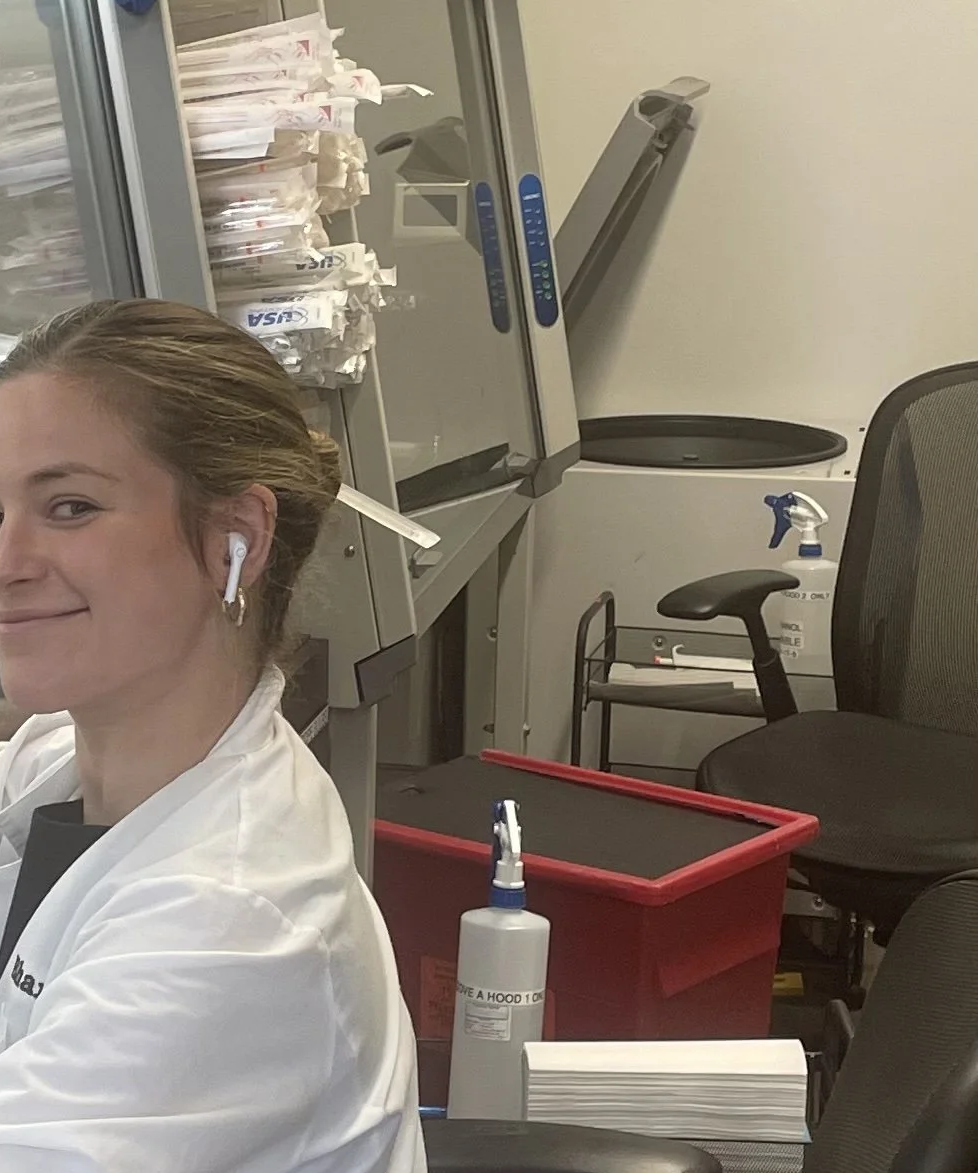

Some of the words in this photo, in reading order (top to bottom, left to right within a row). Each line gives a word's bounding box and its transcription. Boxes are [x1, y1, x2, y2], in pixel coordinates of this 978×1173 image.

[248, 311, 293, 327] USA
[476, 990, 484, 1000] A
[487, 992, 522, 1004] HOOD
[525, 994, 530, 1003] 1
